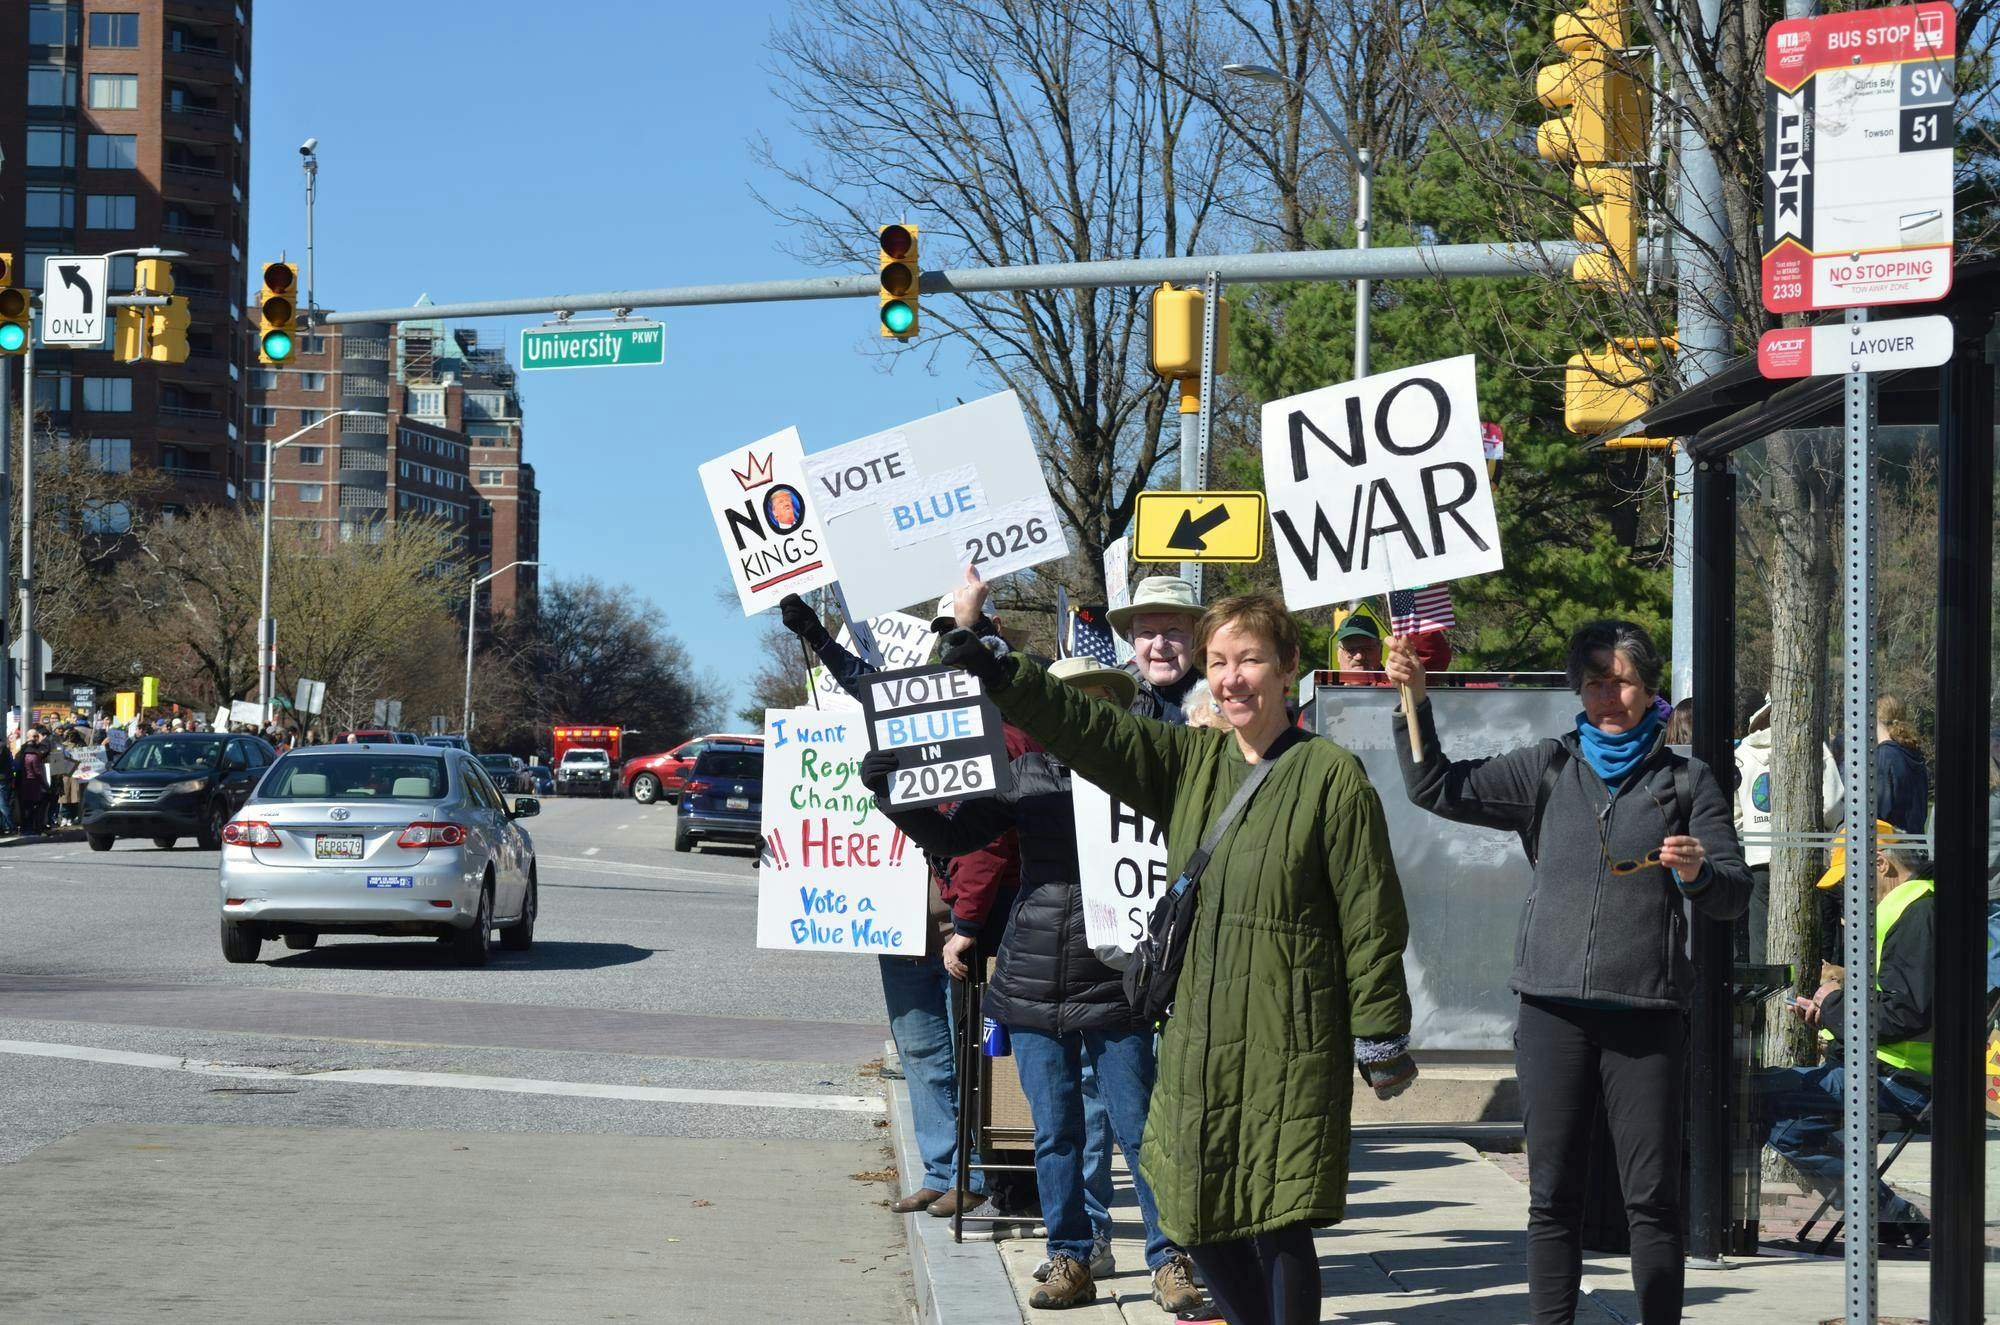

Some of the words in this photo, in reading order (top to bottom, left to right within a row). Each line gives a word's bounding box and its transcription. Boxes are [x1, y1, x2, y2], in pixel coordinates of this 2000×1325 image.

[1777, 32, 1798, 48] MTA
[1828, 30, 1862, 50] BUS
[1866, 25, 1910, 46] STOP
[1855, 79, 1878, 90] Curtis
[1881, 78, 1895, 88] Bay
[1910, 68, 1944, 96] SV
[1864, 128, 1894, 138] Towson
[1912, 113, 1938, 143] 51
[1829, 266, 1852, 282] NO
[1855, 261, 1933, 280] STOPPING
[1773, 283, 1802, 300] 2339
[1852, 285, 1868, 294] TOW
[1868, 283, 1888, 293] AWAY
[1890, 282, 1911, 292] ZONE
[52, 318, 95, 335] ONLY
[528, 332, 622, 363] University
[632, 331, 659, 344] PKWY
[1850, 336, 1914, 355] LAYOVER
[1288, 377, 1452, 482] NO
[821, 452, 906, 498] VOTE
[725, 484, 806, 551] NO
[893, 485, 976, 532] BLUE
[1272, 461, 1490, 581] WAR
[741, 529, 818, 581] KINGS
[966, 518, 1048, 565] 2026
[882, 671, 968, 707] VOTE
[772, 719, 788, 748] I
[797, 725, 847, 743] want
[887, 709, 971, 746] BLUE
[921, 744, 942, 761] IN
[899, 760, 982, 800] 2026
[790, 784, 879, 826] Change
[1754, 815, 1771, 824] Ima
[802, 818, 880, 868] HERE
[800, 886, 847, 916] Vote
[857, 896, 877, 912] a
[790, 918, 844, 944] Blue
